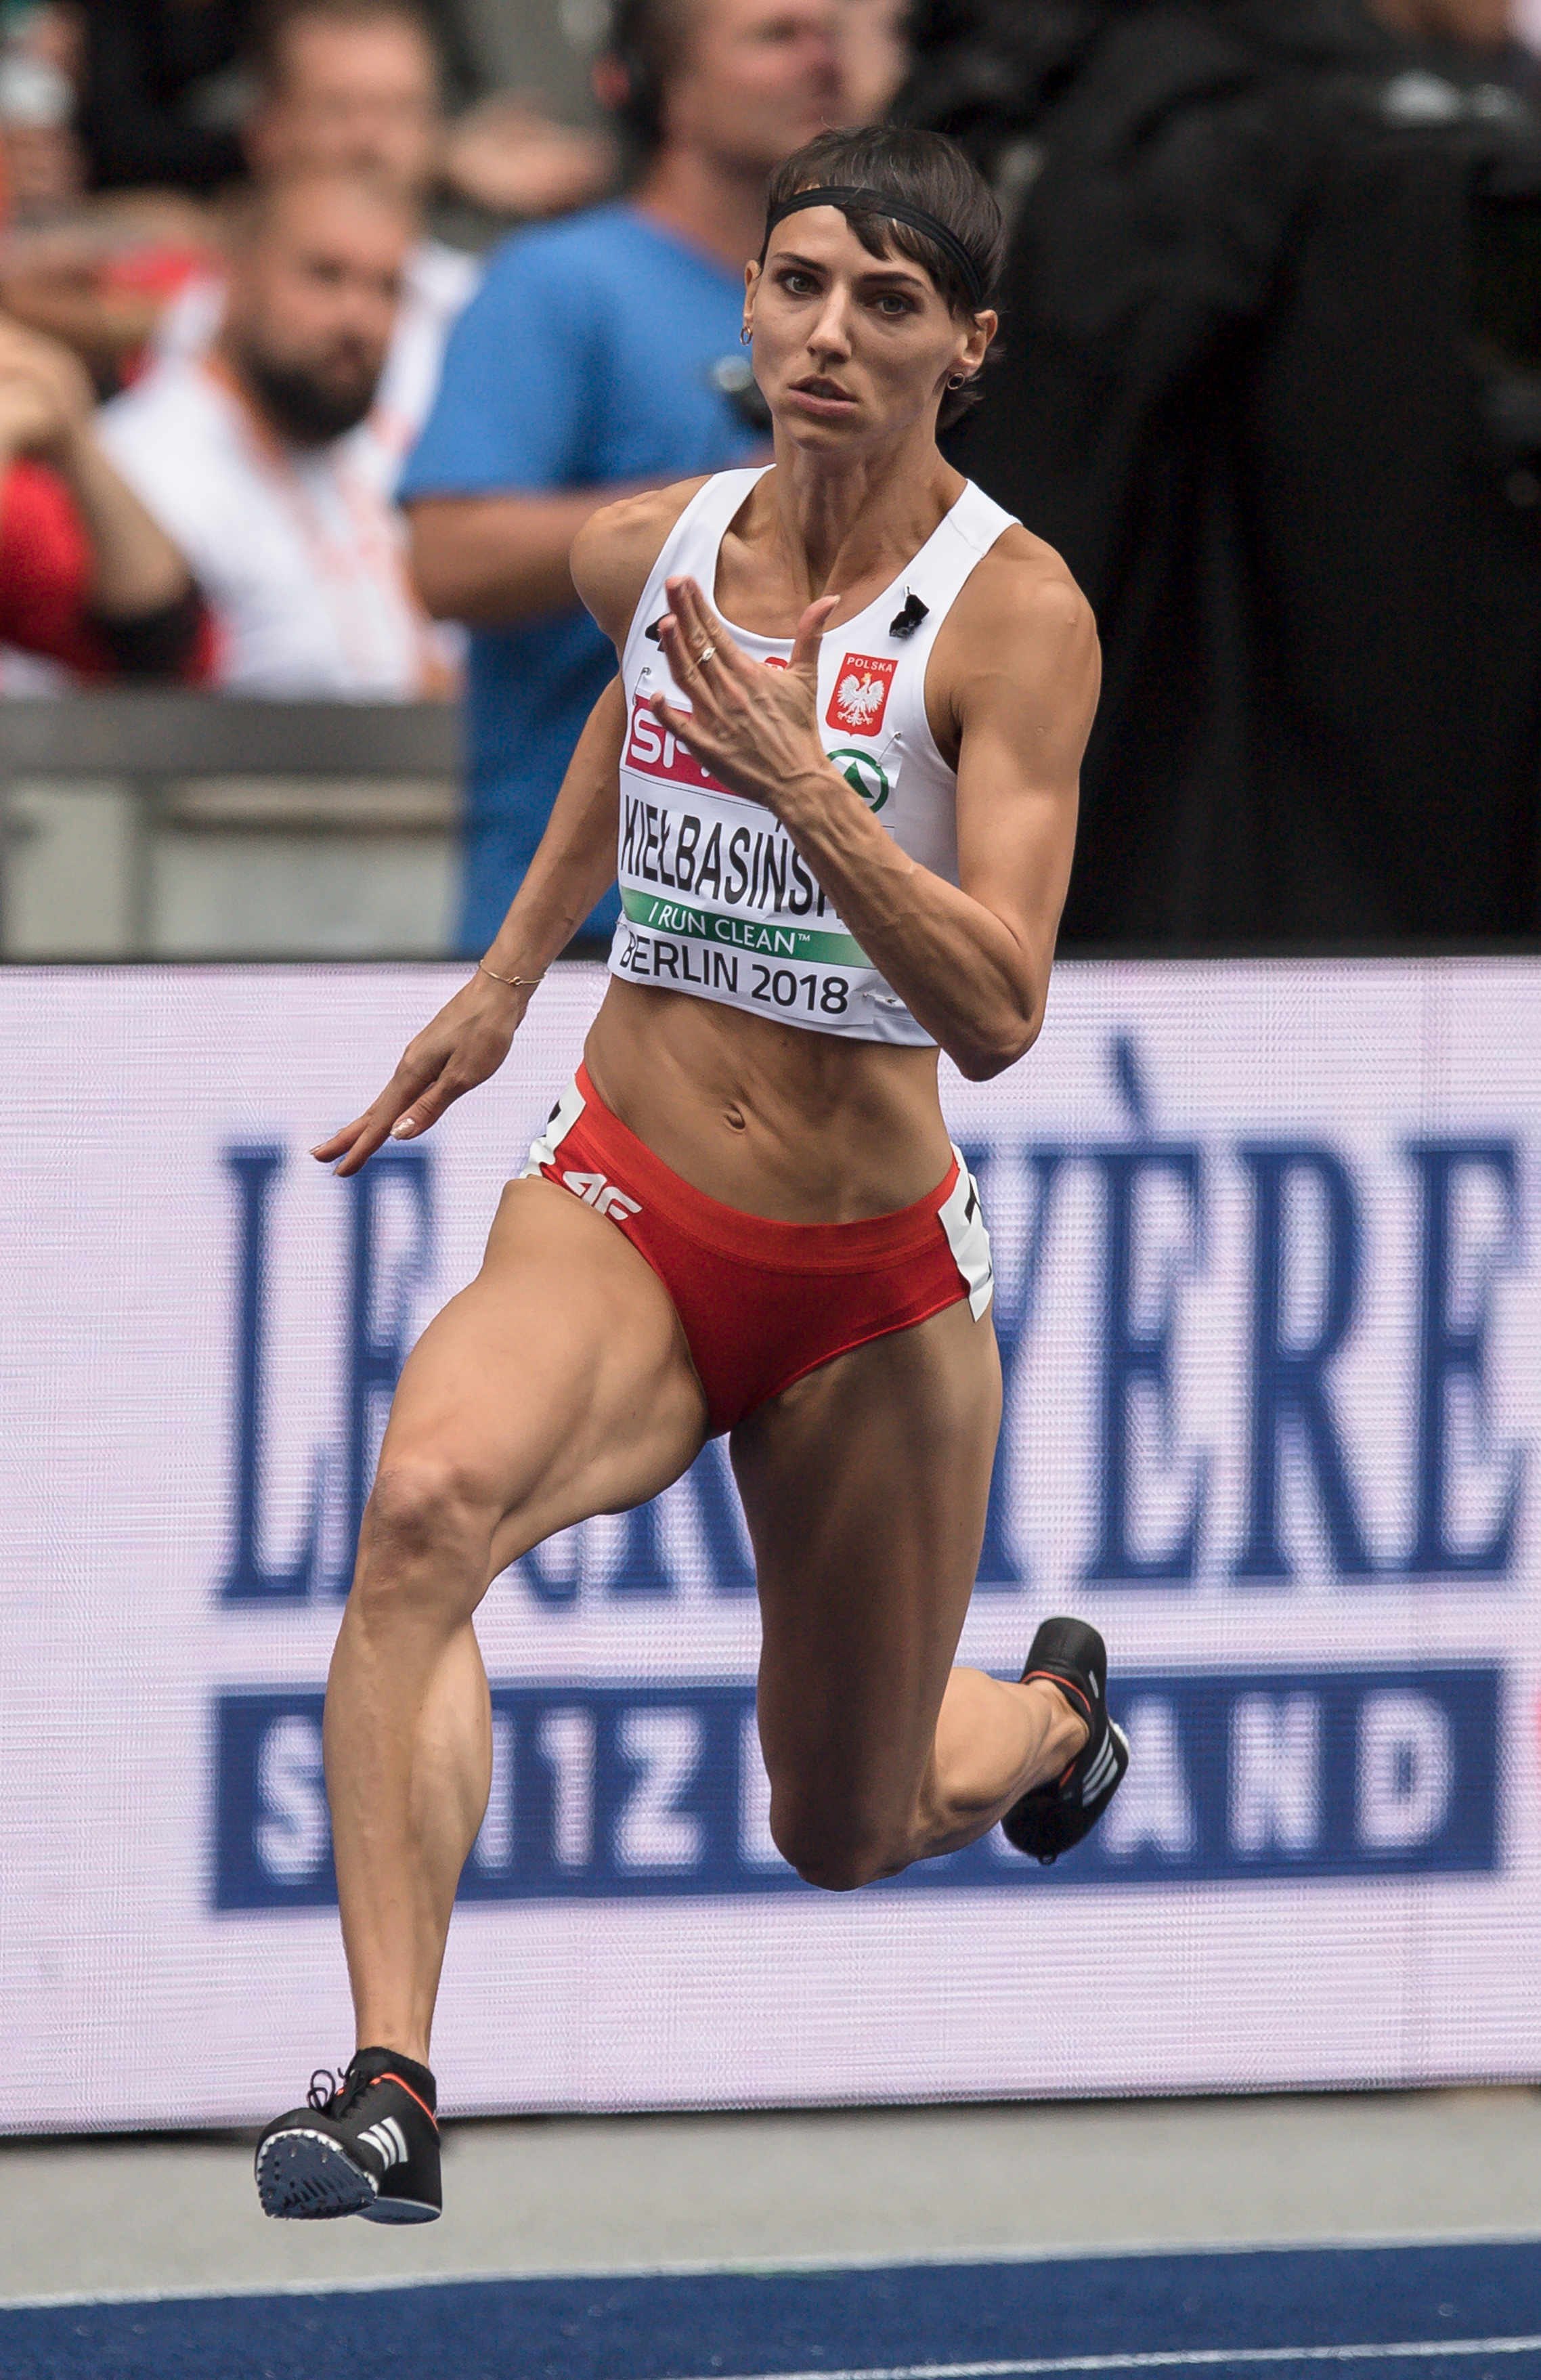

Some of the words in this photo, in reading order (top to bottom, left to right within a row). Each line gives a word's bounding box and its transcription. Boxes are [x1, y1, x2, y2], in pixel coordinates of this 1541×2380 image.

[846, 657, 893, 673] POLSKA
[620, 795, 842, 919] KIEŁBASIŃS
[648, 901, 659, 923] I
[657, 905, 706, 936] RUN
[620, 930, 738, 993] BERLIN
[751, 964, 849, 1015] 2018
